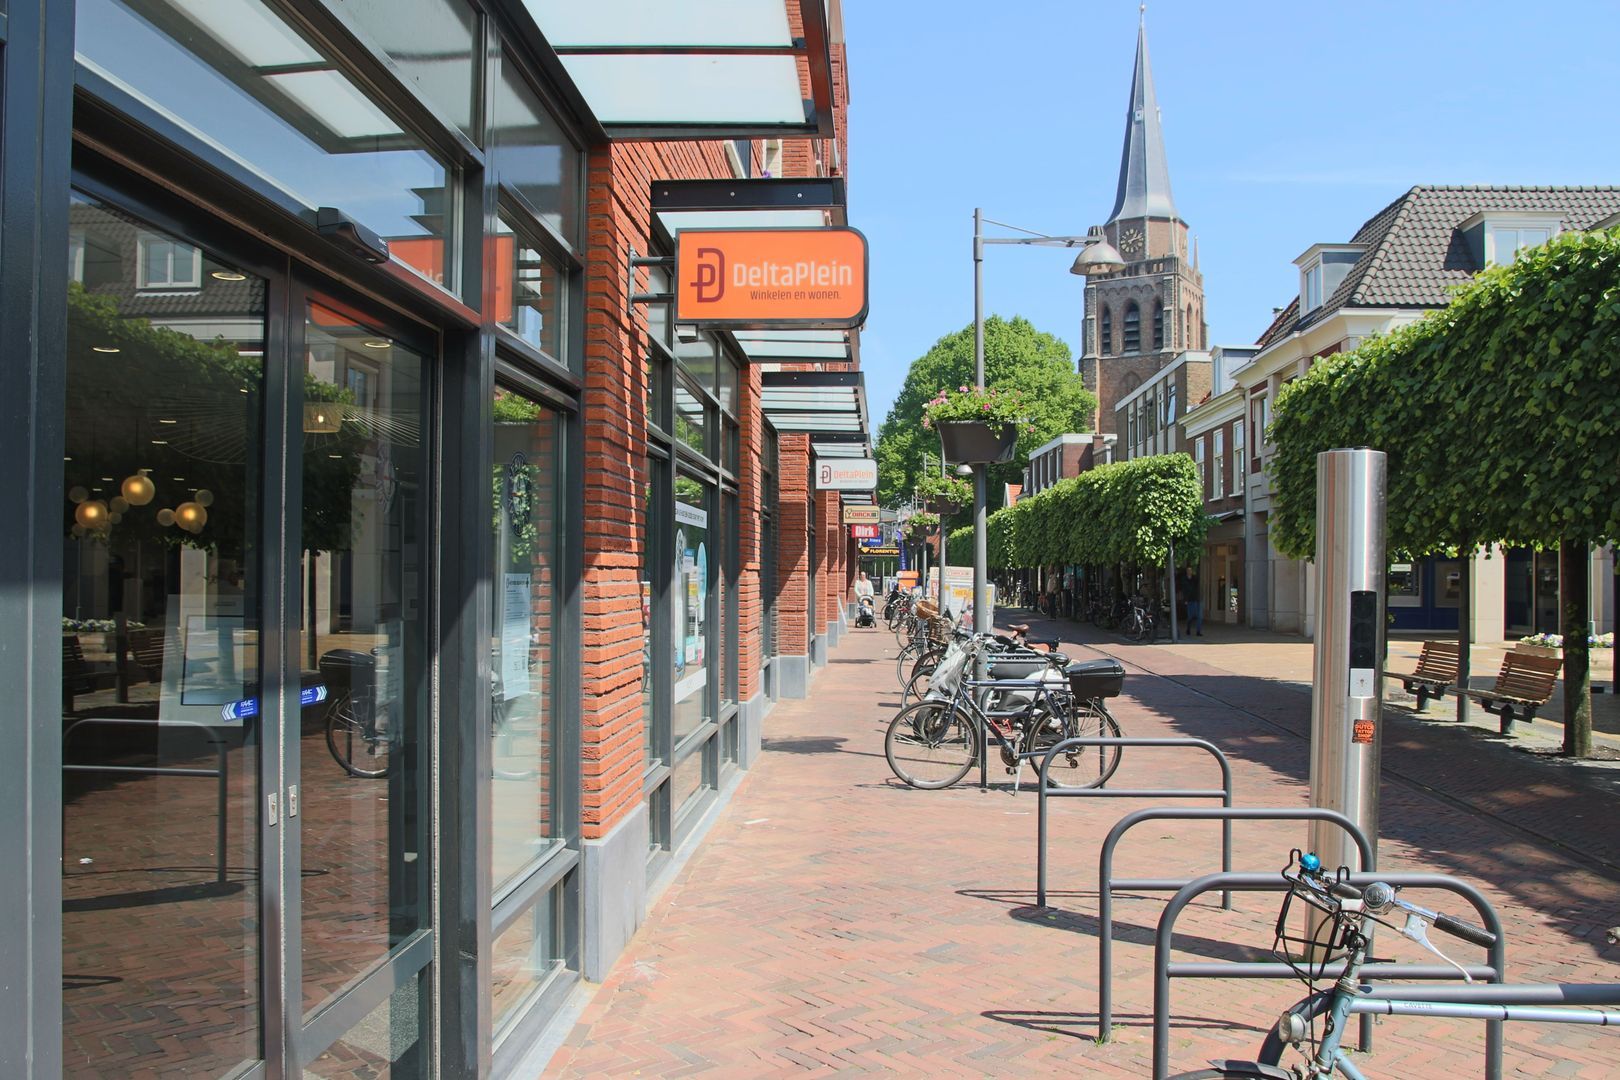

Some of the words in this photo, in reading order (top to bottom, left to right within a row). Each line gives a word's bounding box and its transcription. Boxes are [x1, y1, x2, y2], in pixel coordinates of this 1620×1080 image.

[733, 261, 852, 287] DeltaPlein
[750, 289, 792, 300] Winkelen
[794, 291, 806, 300] en
[833, 470, 873, 479] DeltaPlein
[855, 525, 875, 538] Dirk
